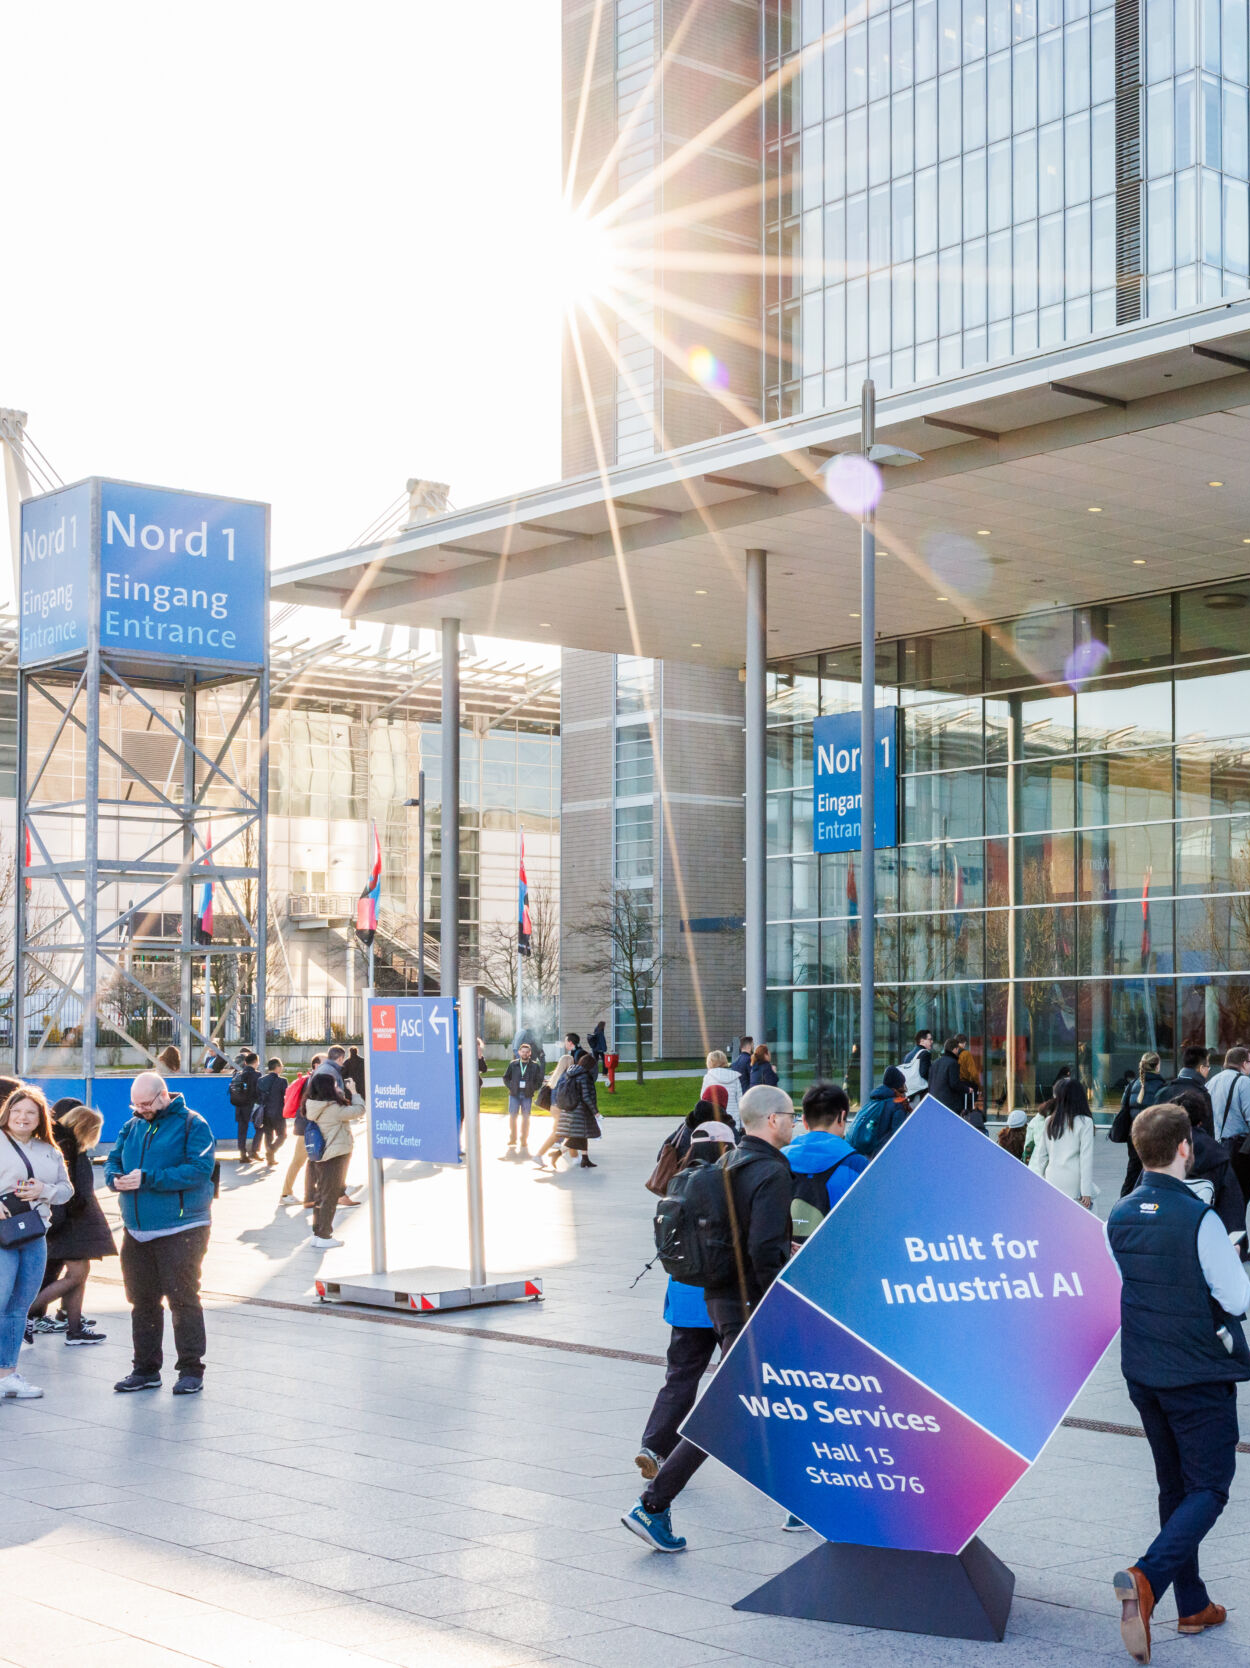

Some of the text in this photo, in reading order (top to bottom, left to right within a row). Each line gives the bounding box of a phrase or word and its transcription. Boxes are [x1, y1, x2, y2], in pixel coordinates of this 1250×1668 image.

[23, 515, 78, 564] Nord 1
[106, 510, 235, 561] Nord 1
[23, 583, 74, 618] Eingang
[106, 572, 229, 619] Eingang
[22, 620, 77, 652] Entrance
[106, 610, 237, 648] Entrance
[818, 736, 890, 776] Nor 1
[818, 793, 863, 817] Eingan
[818, 820, 877, 840] Entran
[400, 1019, 423, 1037] ASC
[374, 1084, 407, 1096] Aussteller
[375, 1097, 420, 1110] Service Center
[376, 1120, 405, 1132] Exhibitor
[376, 1134, 422, 1147] Service Center
[905, 1233, 1040, 1262] Built for
[881, 1271, 1084, 1304] Industrial AI
[762, 1362, 883, 1394] Amazon
[738, 1394, 941, 1433] Web Services
[811, 1441, 895, 1466] Hall 15
[805, 1466, 925, 1494] Stand D76
